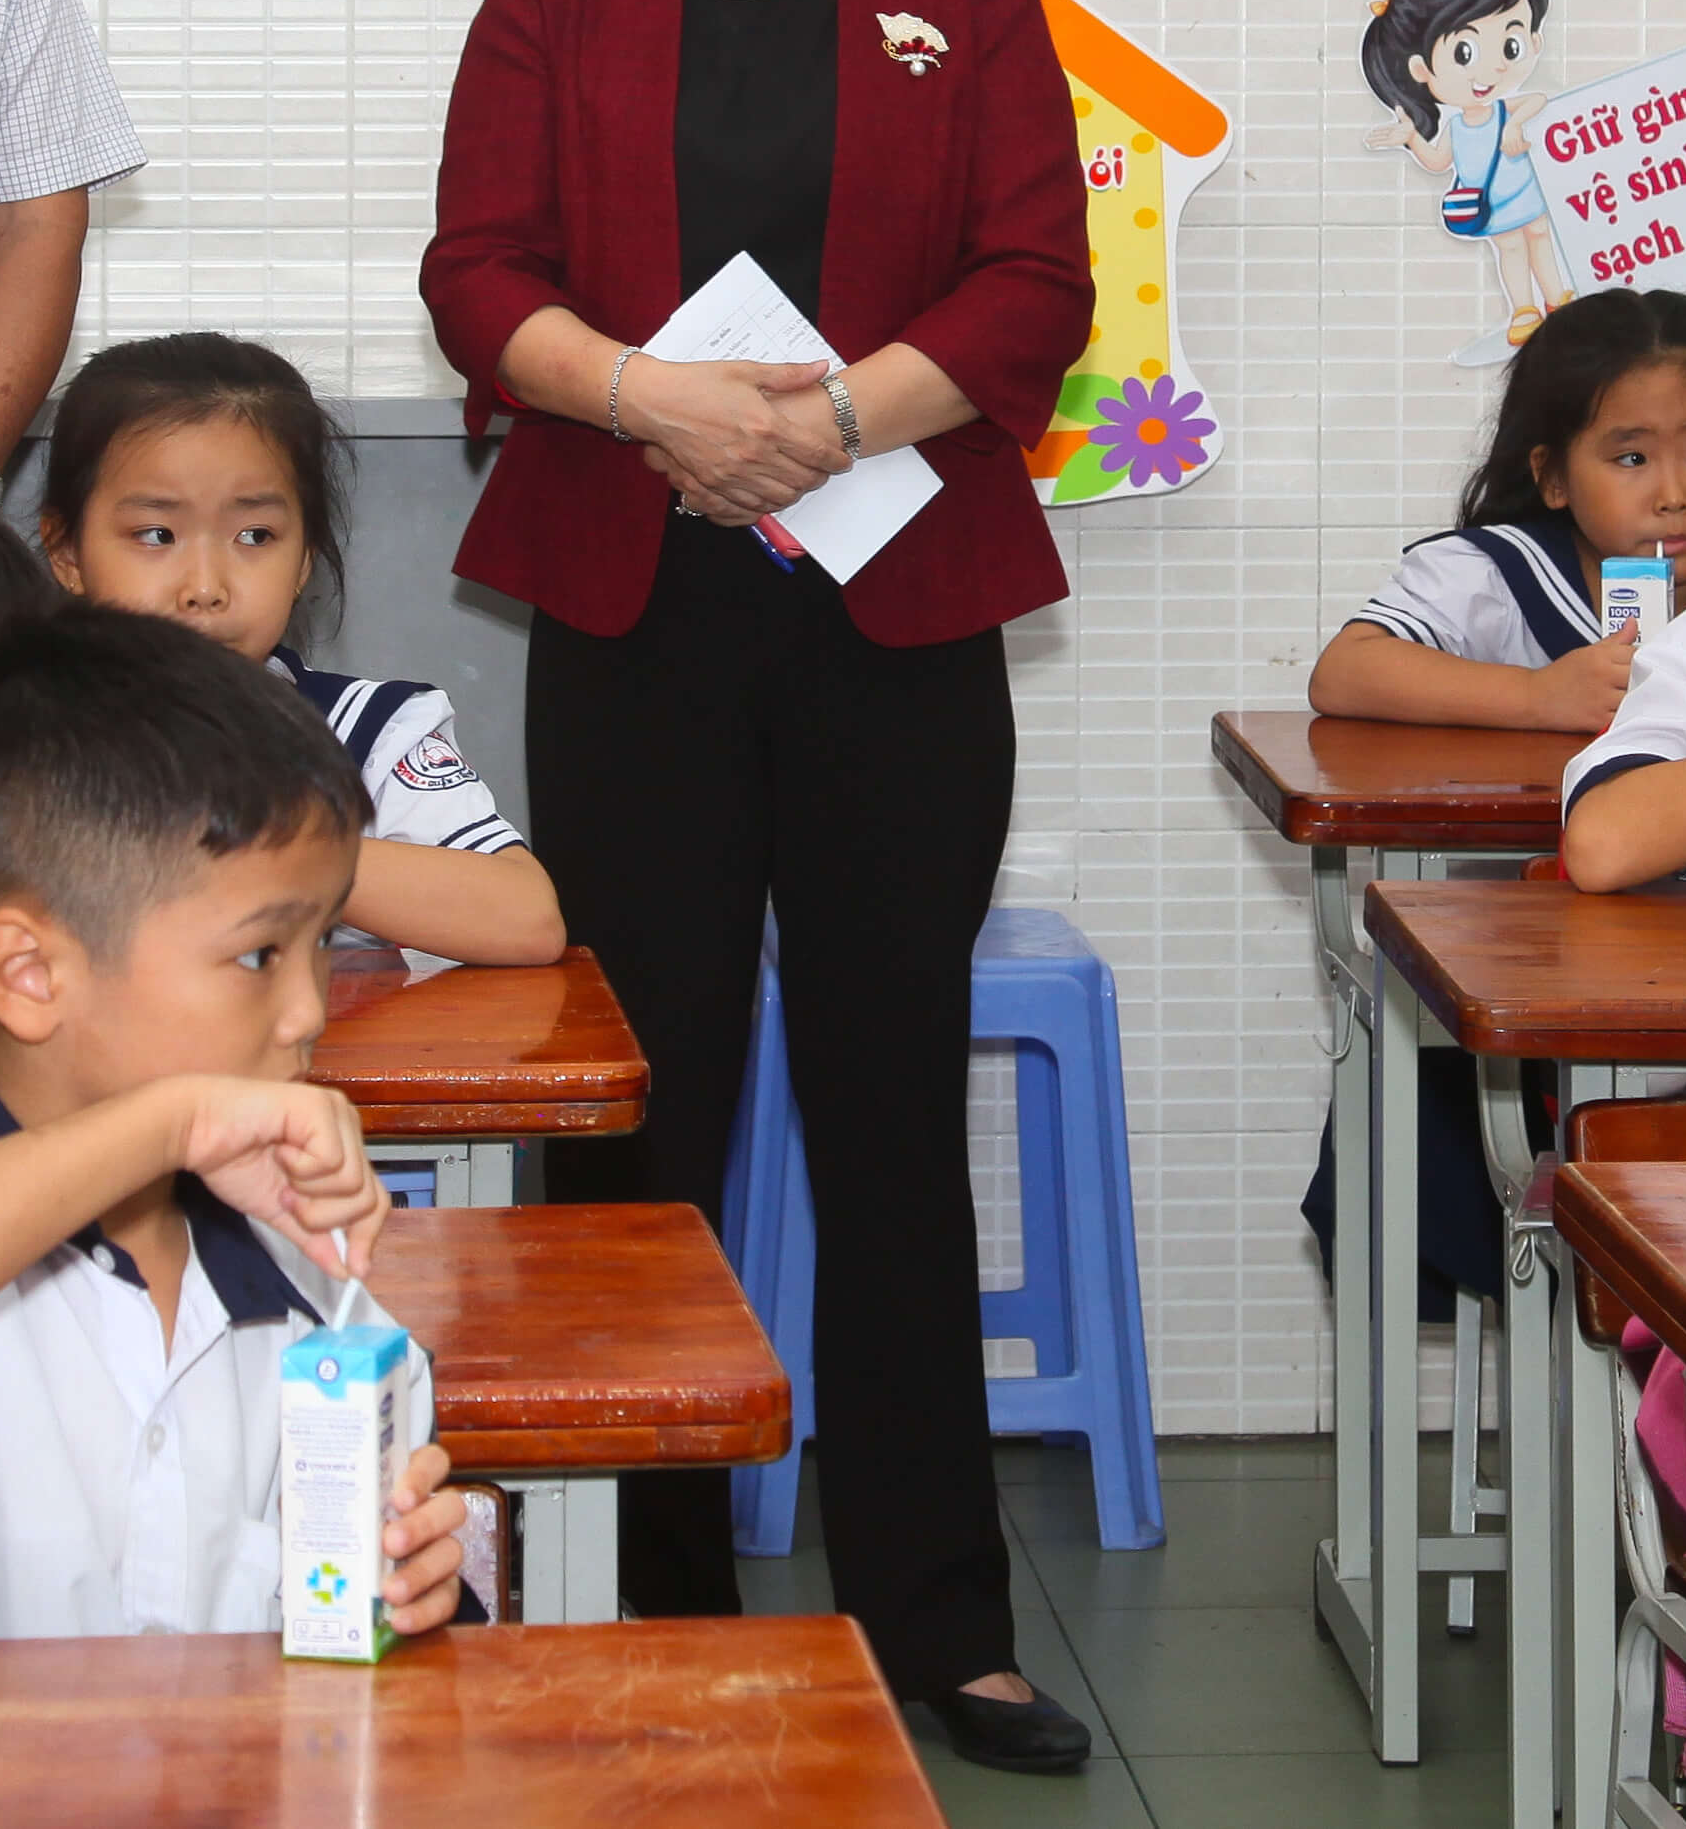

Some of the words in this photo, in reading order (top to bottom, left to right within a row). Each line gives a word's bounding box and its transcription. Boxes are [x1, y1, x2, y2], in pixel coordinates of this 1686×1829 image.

[1544, 103, 1624, 164] Giữ
[1565, 171, 1619, 226] vệ
[1590, 218, 1686, 286] sạch
